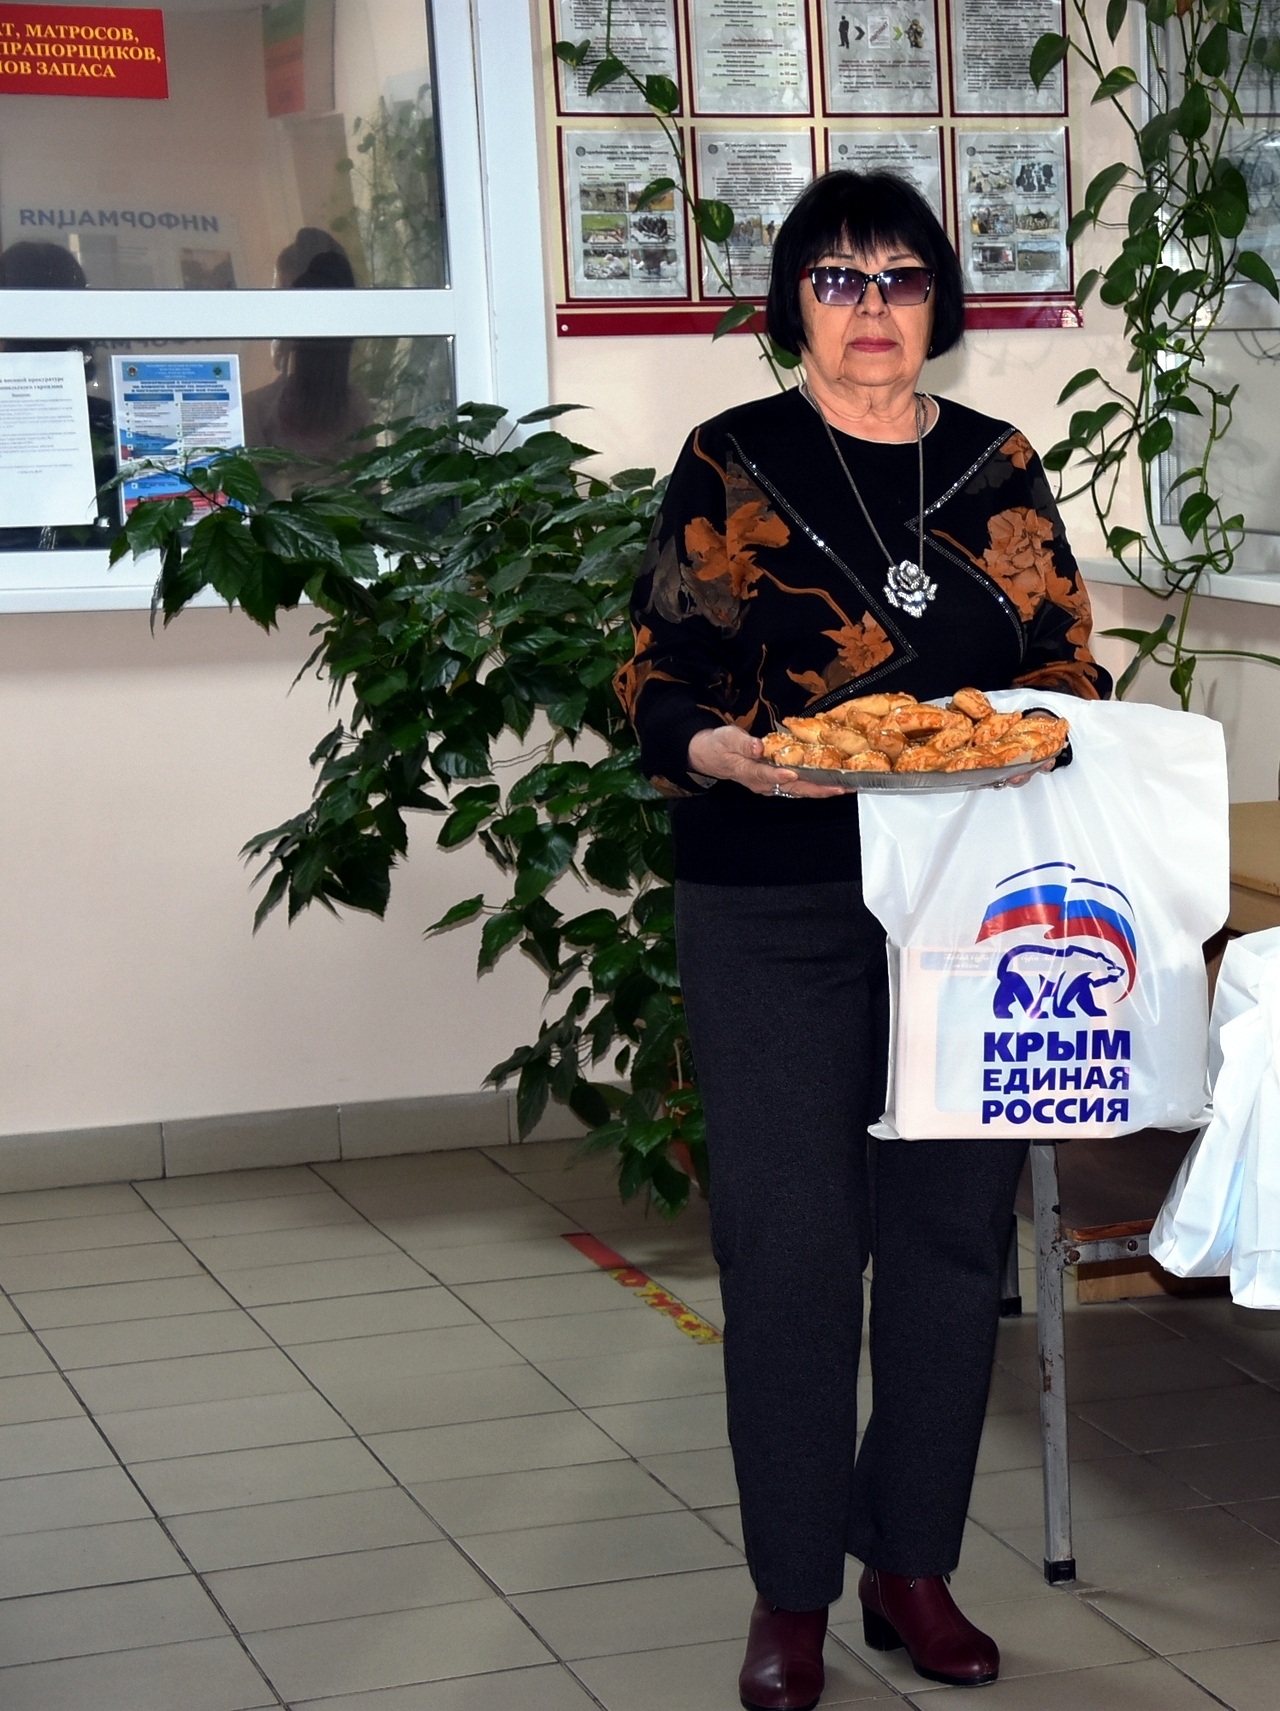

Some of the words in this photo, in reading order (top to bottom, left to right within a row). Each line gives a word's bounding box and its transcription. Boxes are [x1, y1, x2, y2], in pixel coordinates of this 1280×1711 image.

[0, 23, 20, 39] Т,
[25, 23, 140, 43] МАТРОСОВ,
[36, 61, 117, 78] ЗАПАСА
[983, 1030, 1131, 1062] КРЫМ
[983, 1066, 1130, 1094] ЕДИНАЯ
[982, 1098, 1129, 1124] РОССИЯ
